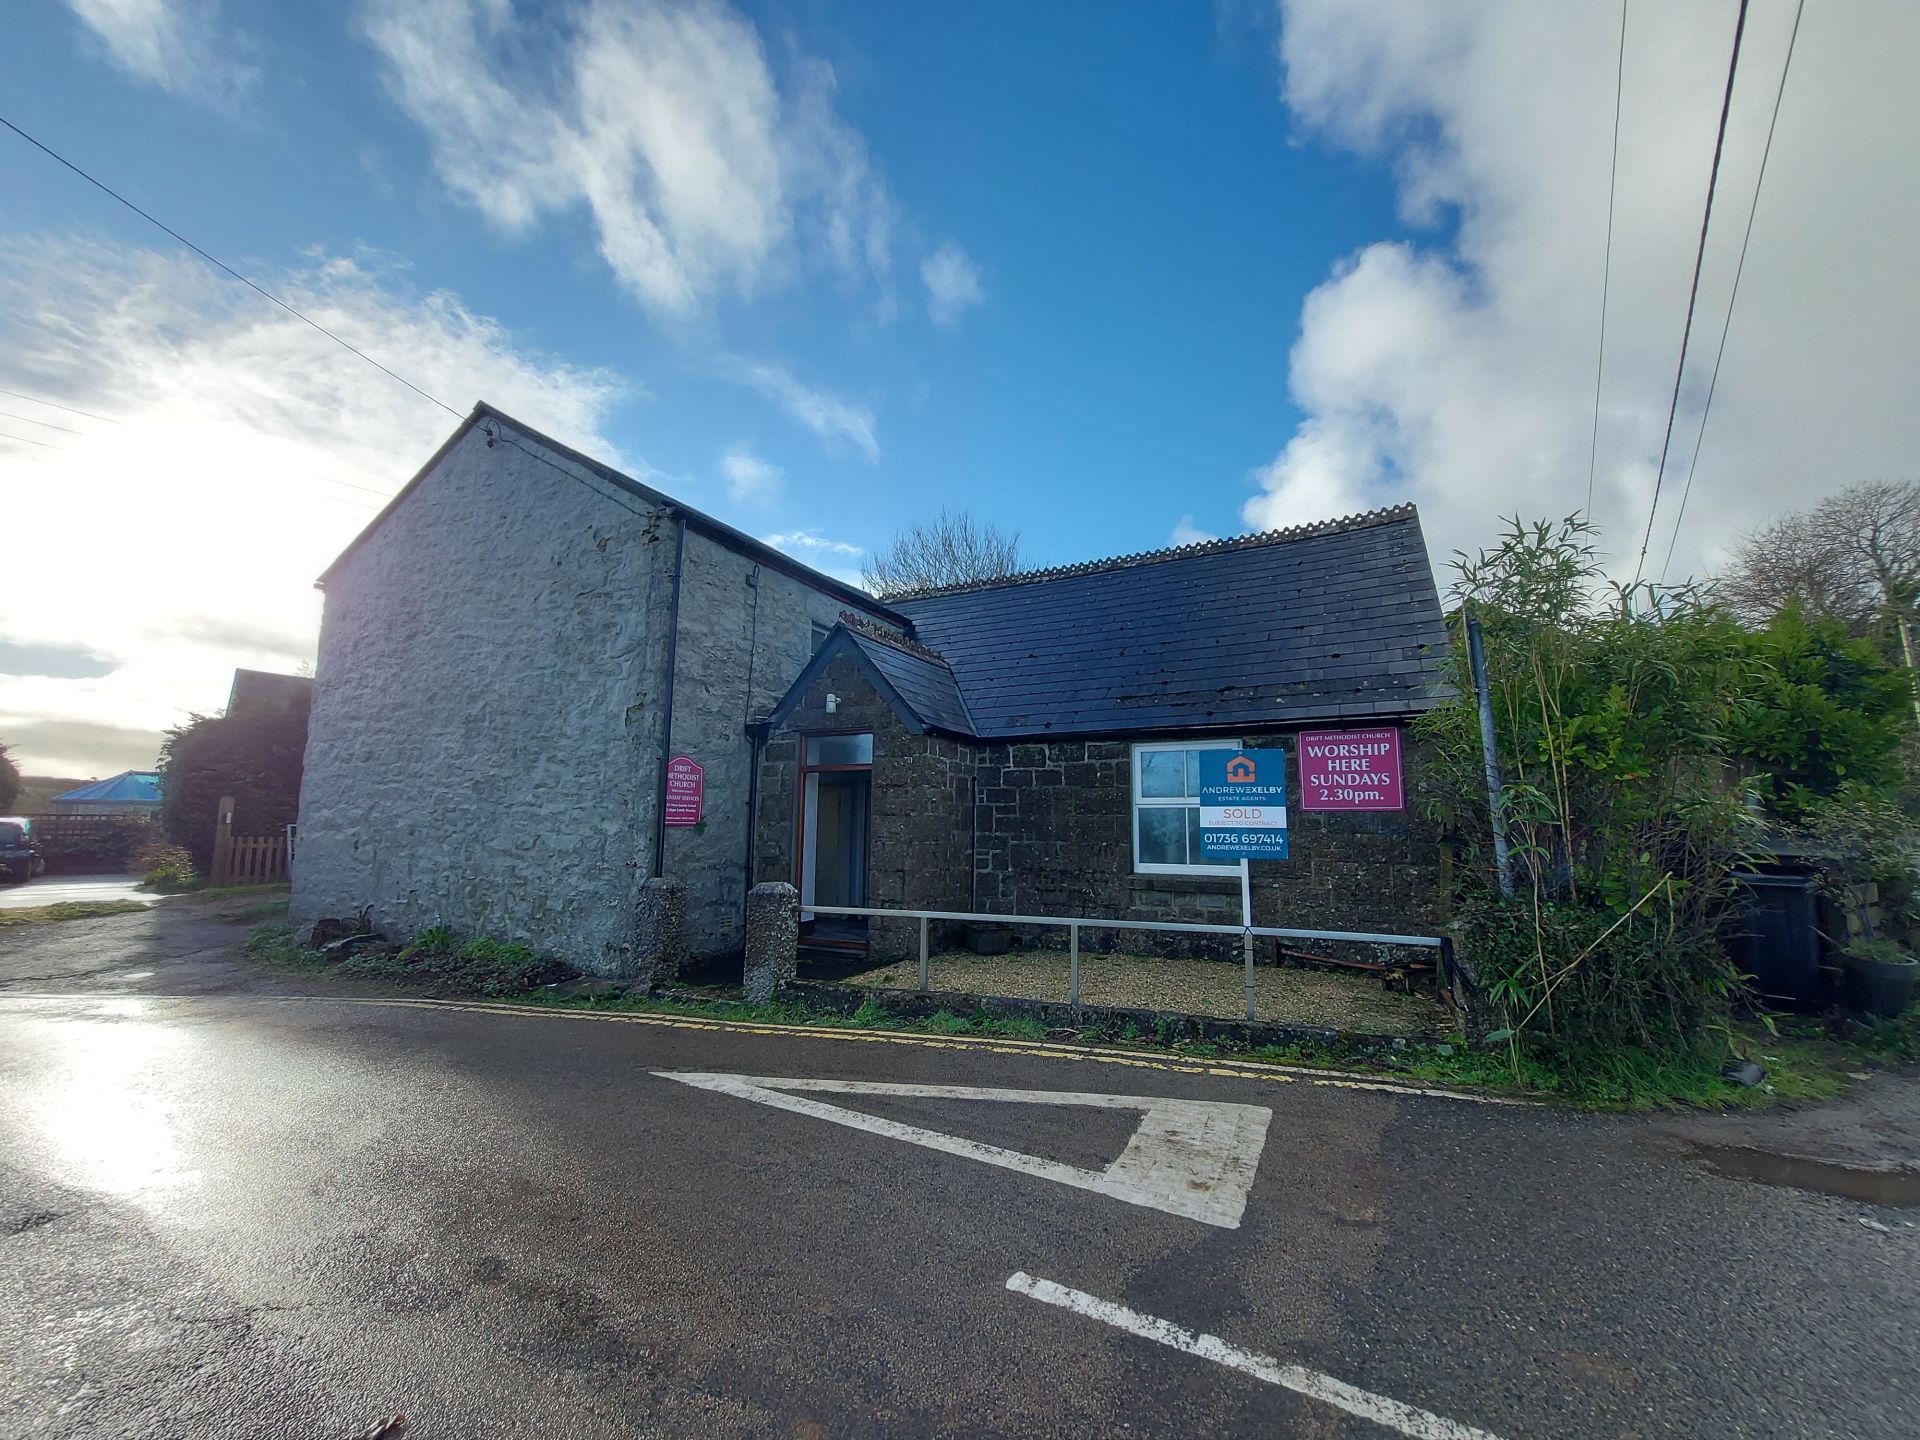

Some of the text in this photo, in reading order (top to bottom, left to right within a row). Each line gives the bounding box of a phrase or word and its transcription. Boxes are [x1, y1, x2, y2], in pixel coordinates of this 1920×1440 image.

[1308, 743, 1390, 757] WORSHIP
[1328, 758, 1370, 771] HERE
[670, 780, 696, 788] CHURCH
[1310, 772, 1390, 786] SUNDAYS
[1320, 788, 1384, 804] 2.30pm.
[1224, 809, 1262, 819] SOLD
[1204, 834, 1283, 844] 01736 697414
